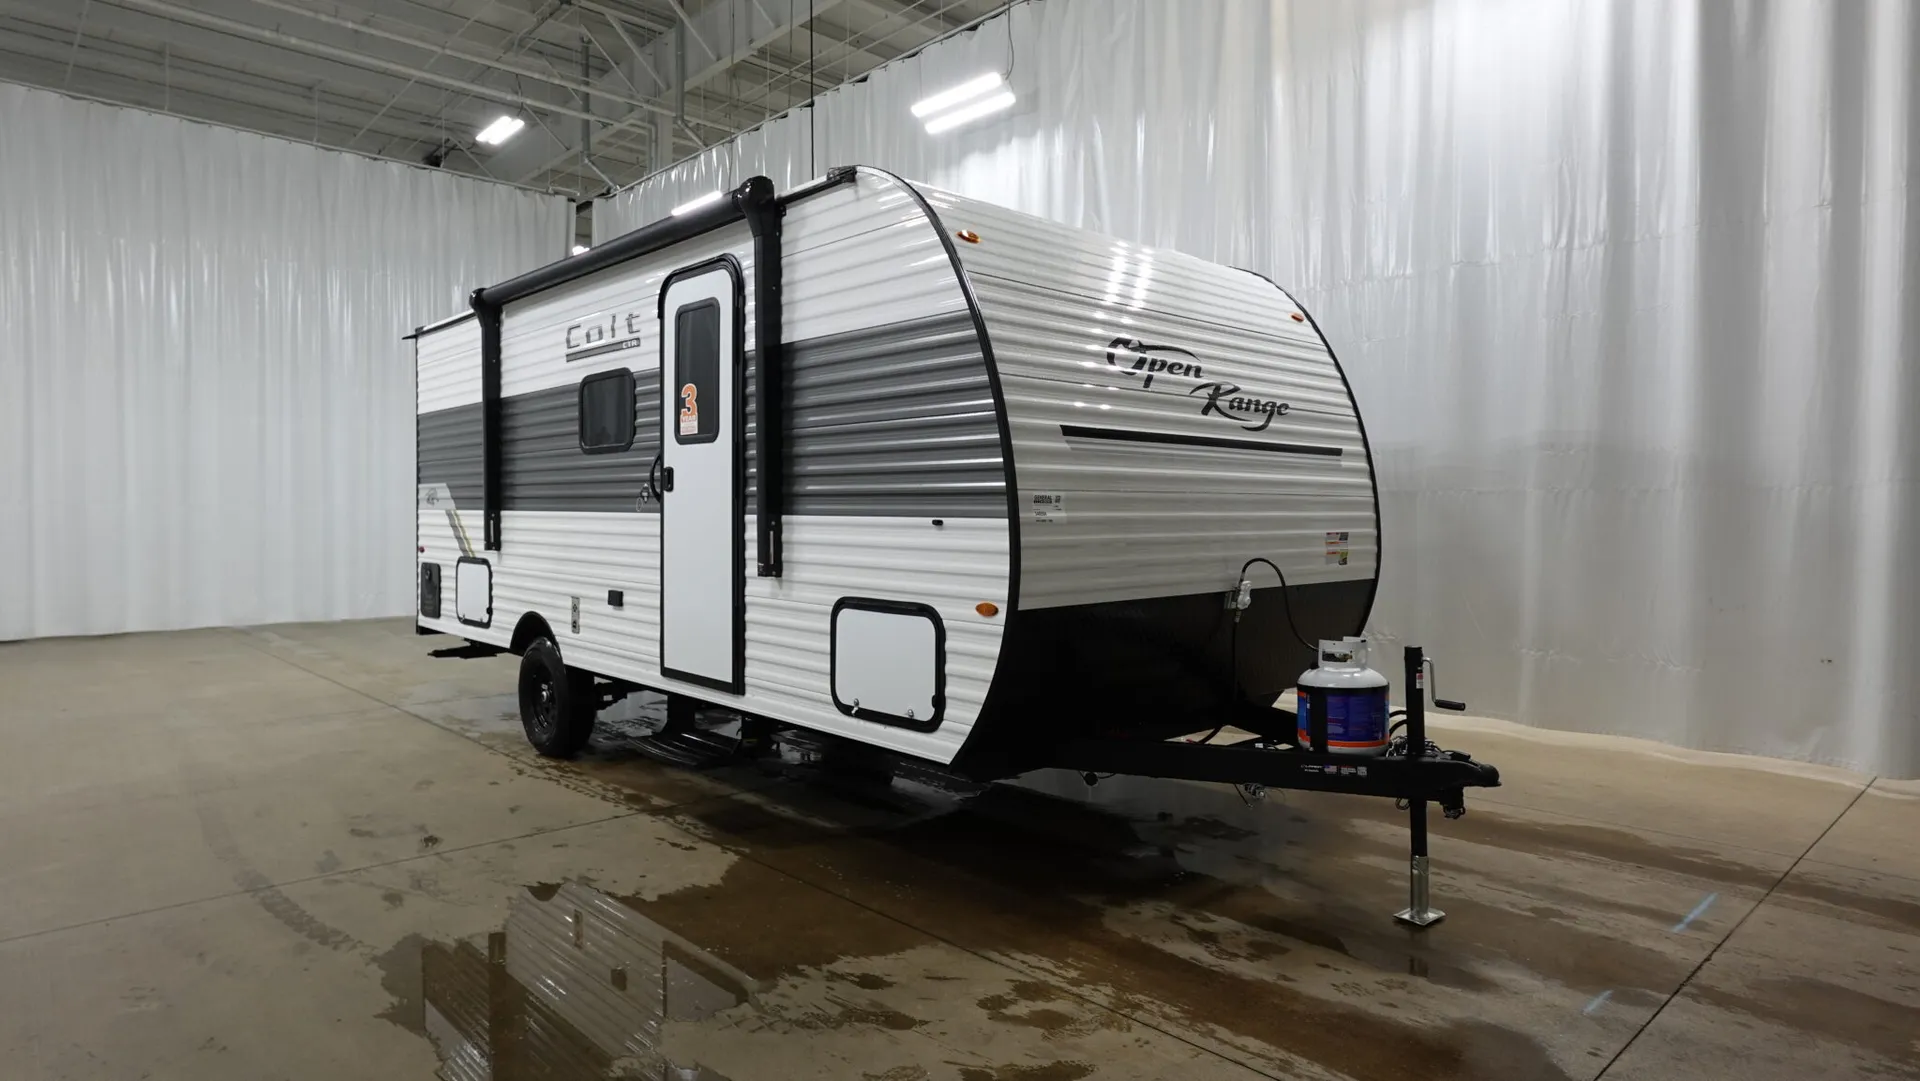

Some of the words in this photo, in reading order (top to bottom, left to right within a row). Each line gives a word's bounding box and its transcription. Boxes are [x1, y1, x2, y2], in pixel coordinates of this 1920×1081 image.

[566, 312, 641, 349] Colt
[622, 340, 638, 349] CTR
[1106, 336, 1204, 389] Open
[681, 383, 698, 417] 3
[1189, 381, 1291, 432] Range
